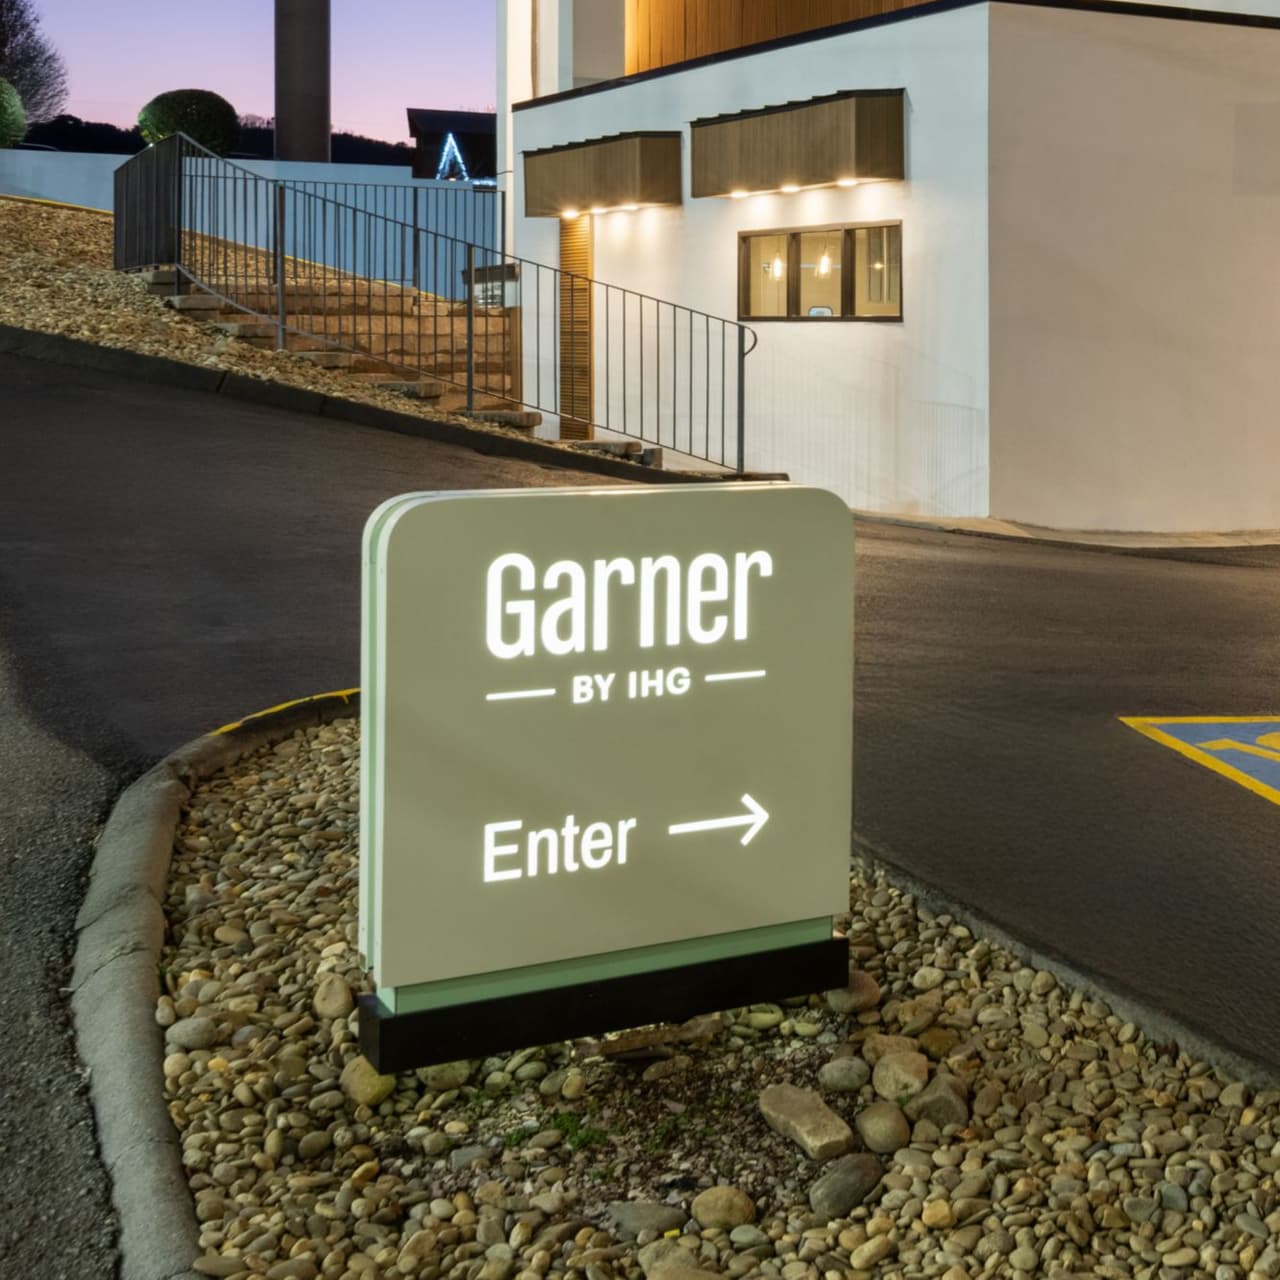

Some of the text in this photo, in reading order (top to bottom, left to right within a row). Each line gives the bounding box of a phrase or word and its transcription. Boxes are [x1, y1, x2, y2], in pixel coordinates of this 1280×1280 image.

[485, 550, 773, 659] Garner
[572, 667, 691, 704] BY IHG
[483, 815, 637, 883] Enter
